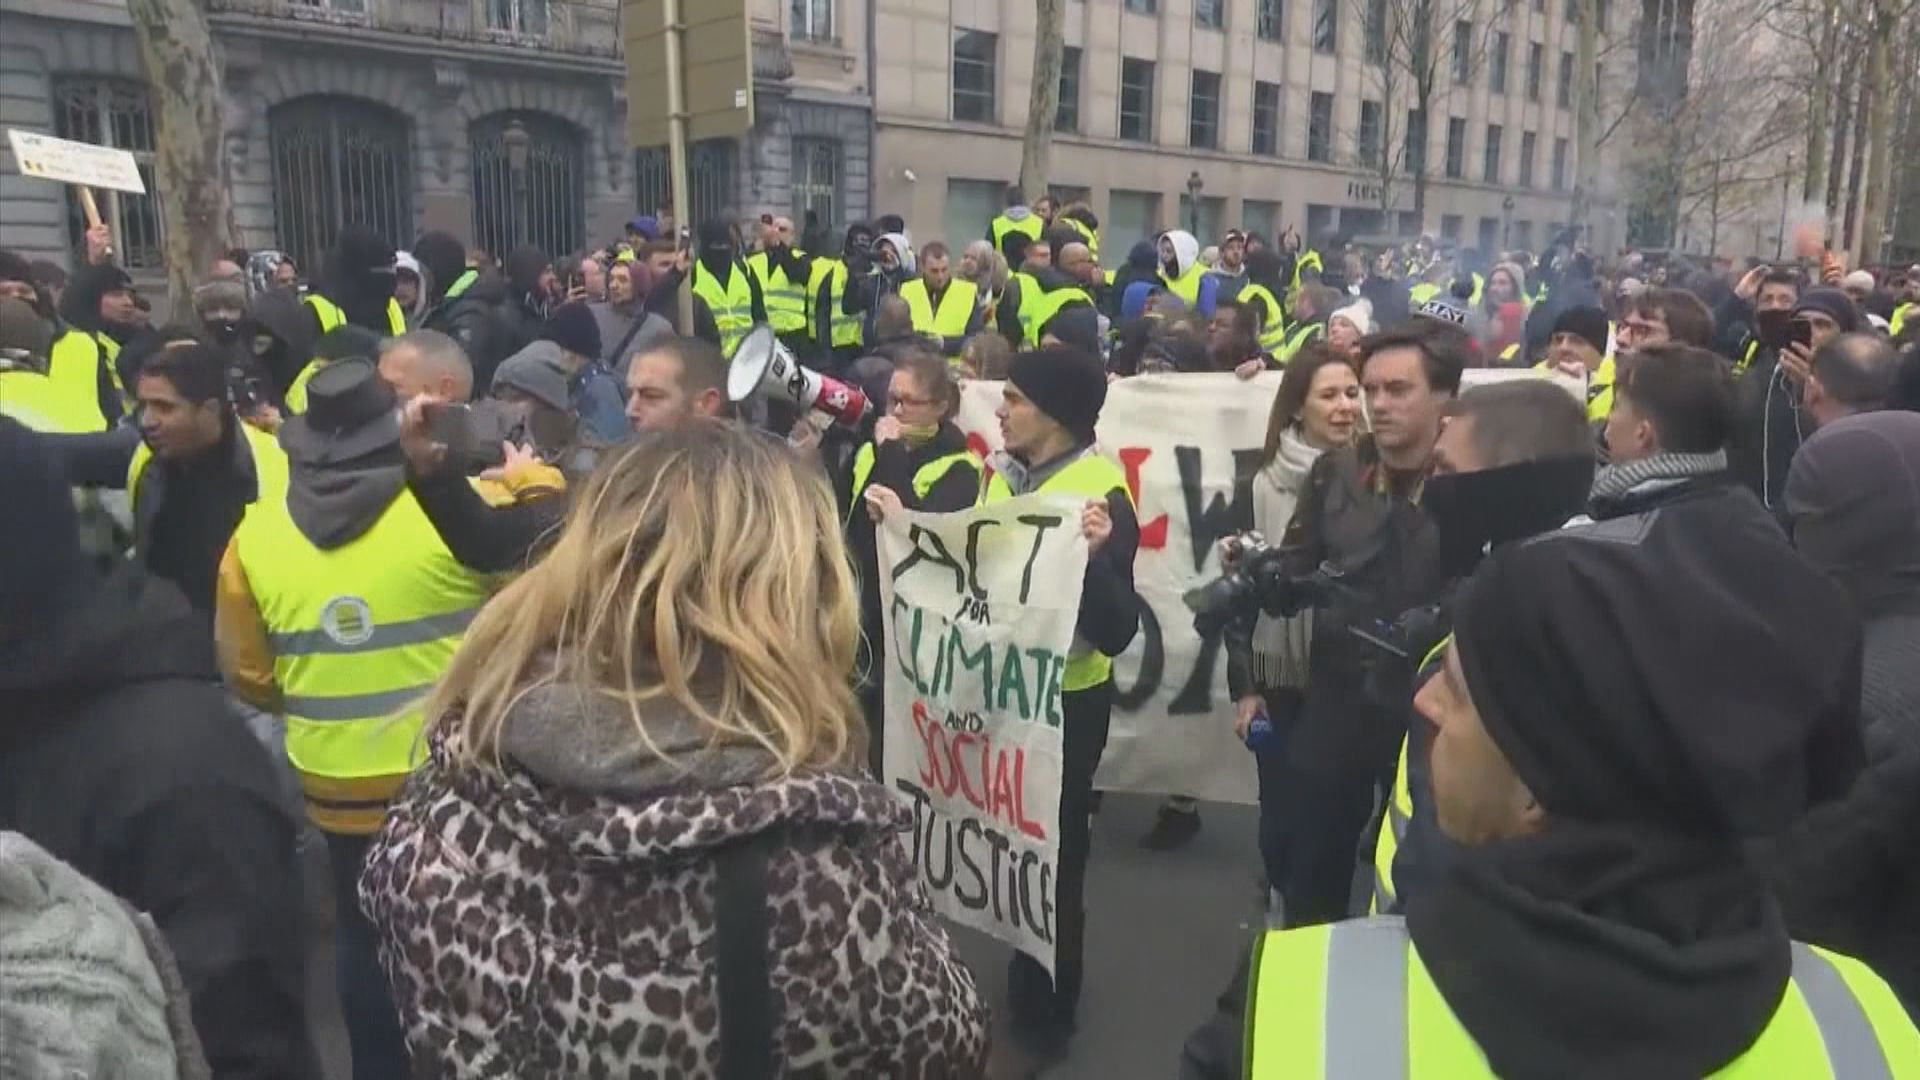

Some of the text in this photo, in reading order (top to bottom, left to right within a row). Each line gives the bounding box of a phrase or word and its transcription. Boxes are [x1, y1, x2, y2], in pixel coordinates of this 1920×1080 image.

[892, 514, 1062, 605] ACT
[954, 596, 991, 626] FOR
[945, 710, 983, 734] AND
